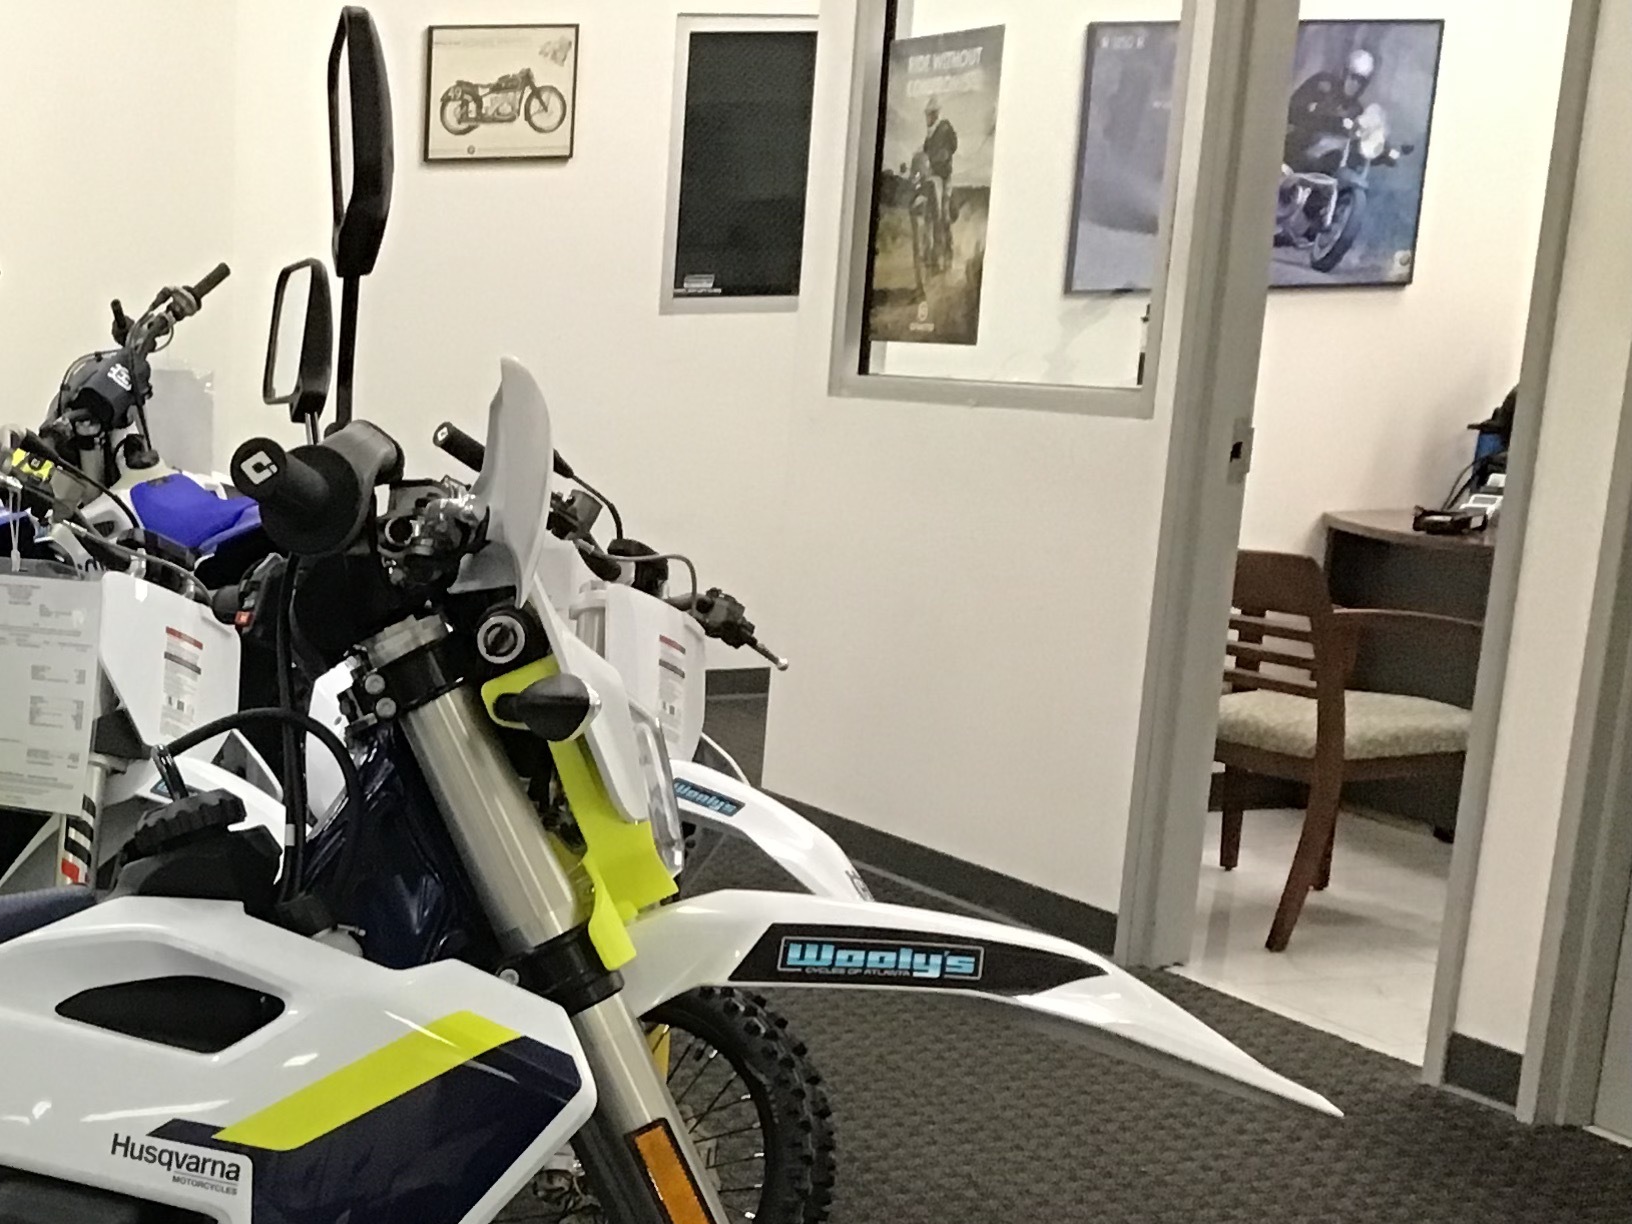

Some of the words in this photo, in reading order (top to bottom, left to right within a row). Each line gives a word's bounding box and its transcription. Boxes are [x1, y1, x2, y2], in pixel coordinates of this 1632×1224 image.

[931, 47, 983, 69] WITHOUT
[786, 942, 976, 979] Wooly's
[804, 966, 846, 976] CYCLES
[847, 968, 863, 976] OF
[863, 968, 911, 977] ATLANTA
[110, 1132, 242, 1182] Husqvarna
[171, 1175, 239, 1196] MOTORCYCLES
